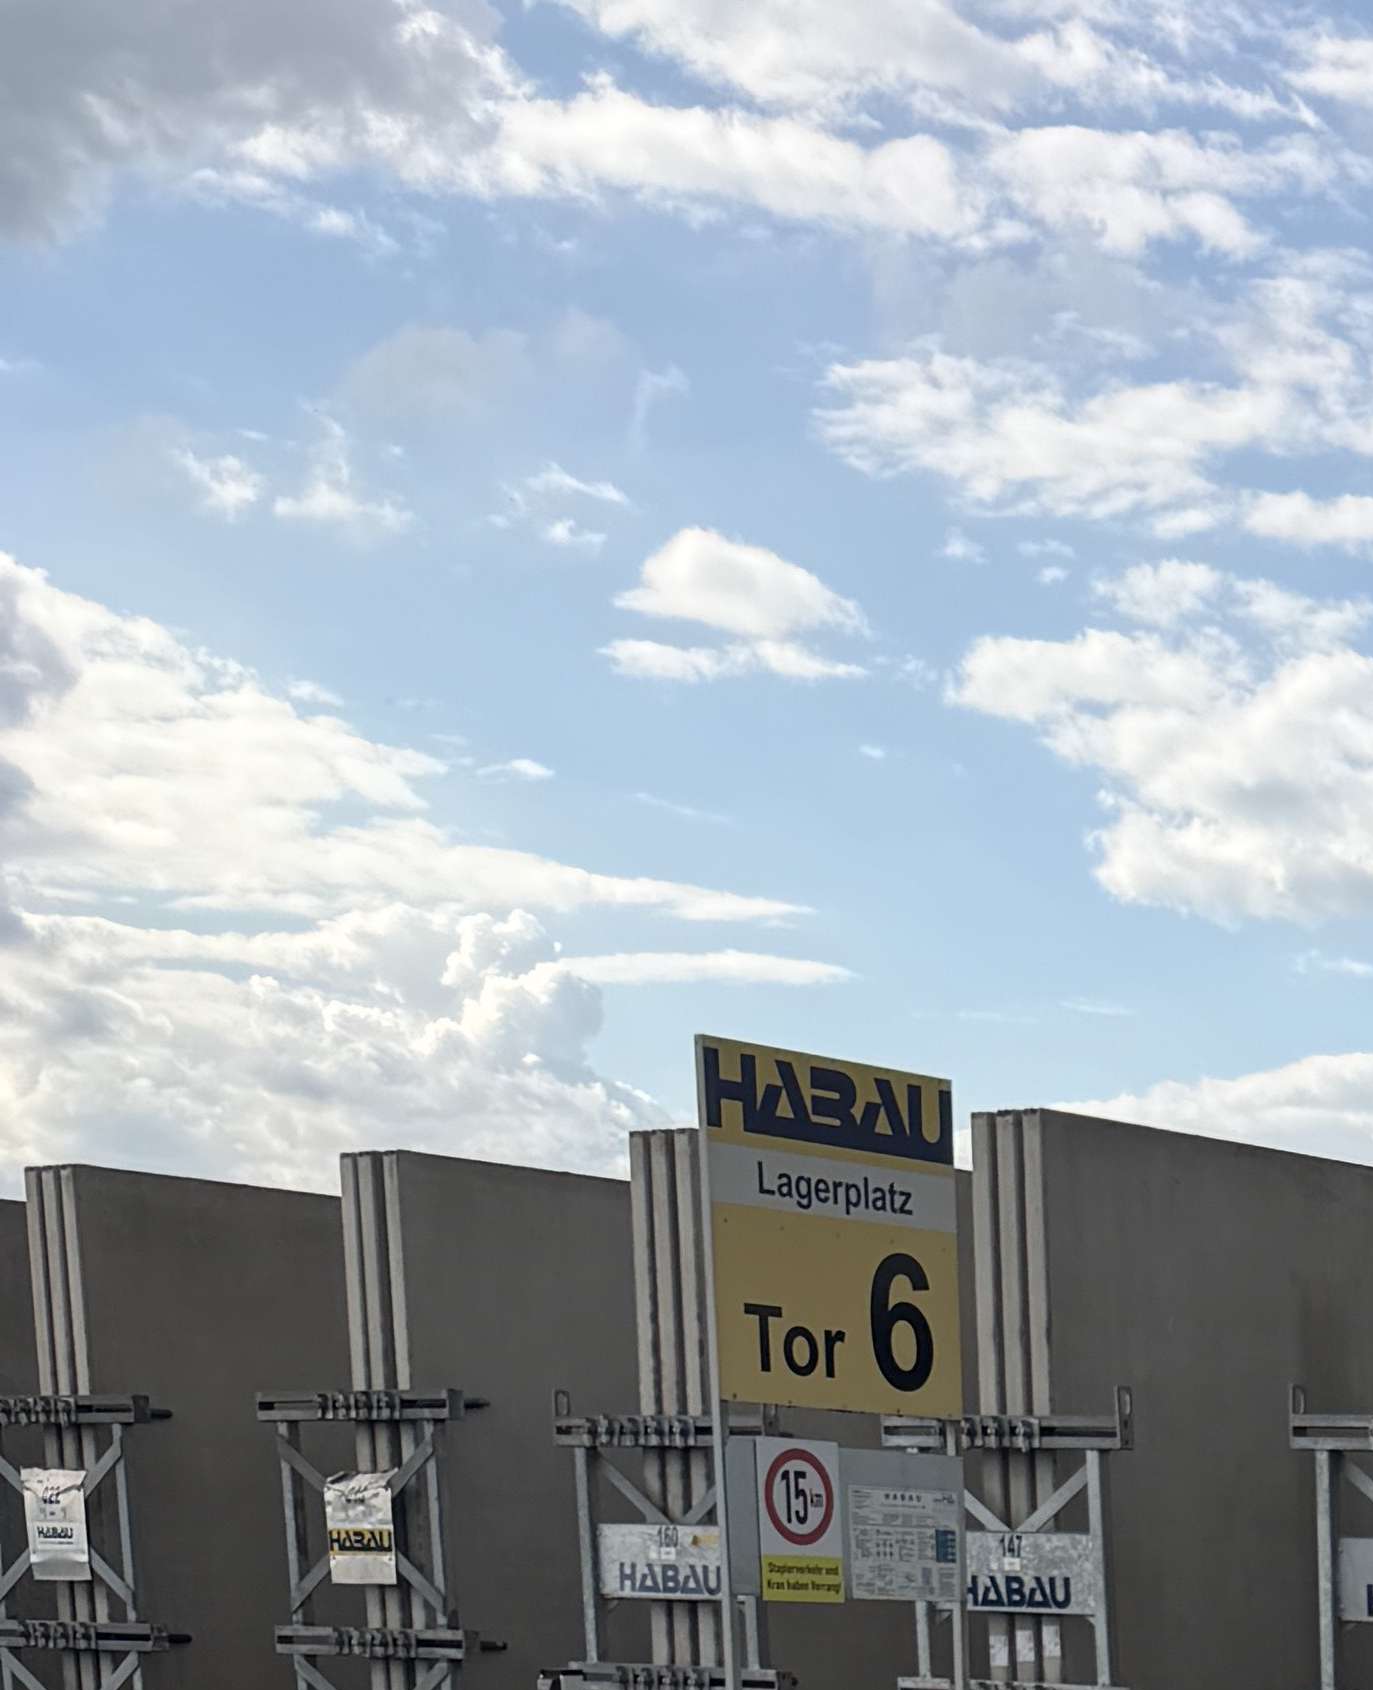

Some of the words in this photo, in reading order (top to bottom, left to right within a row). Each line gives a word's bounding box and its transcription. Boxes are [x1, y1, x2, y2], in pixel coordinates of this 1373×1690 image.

[703, 1046, 953, 1164] HABAU
[757, 1160, 913, 1215] Lagerplatz
[744, 1302, 846, 1378] Tor
[870, 1252, 934, 1392] 6
[781, 1469, 808, 1525] 15
[329, 1529, 393, 1553] HABAU
[1000, 1534, 1023, 1558] 147
[619, 1561, 721, 1596] HABAU
